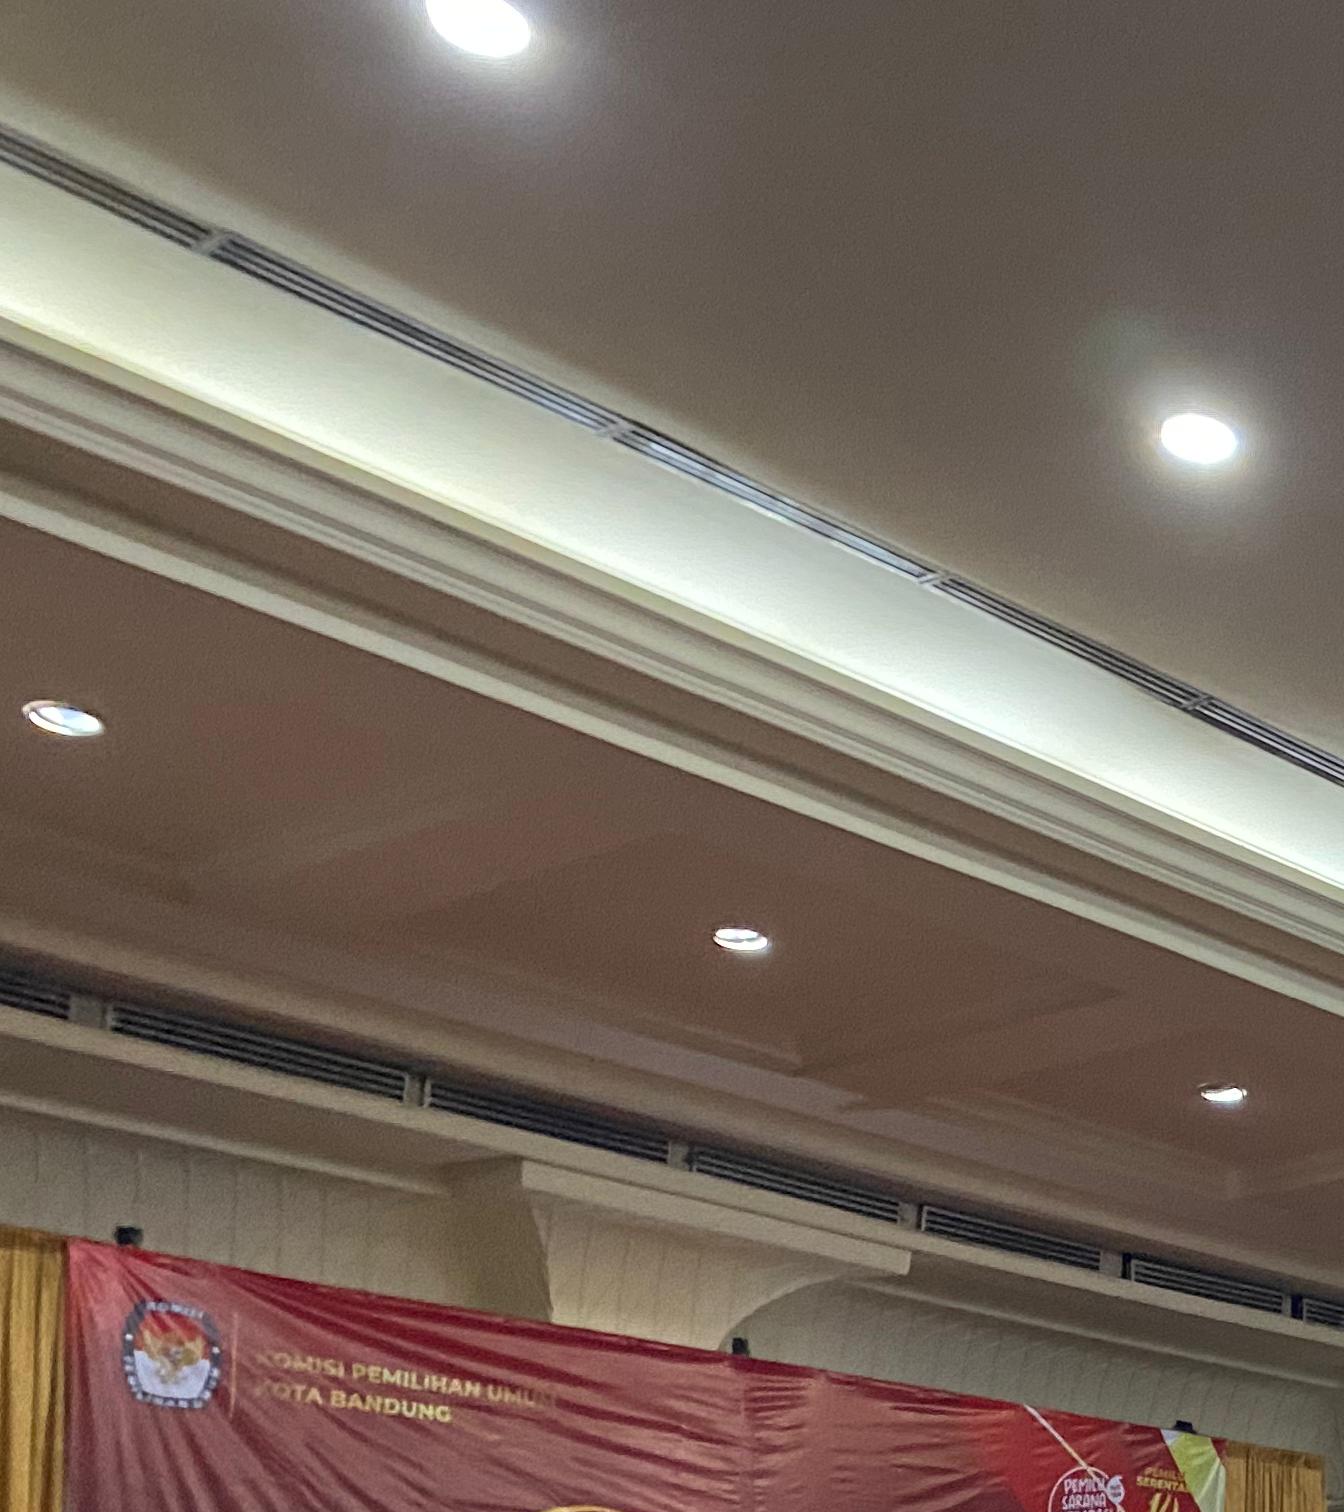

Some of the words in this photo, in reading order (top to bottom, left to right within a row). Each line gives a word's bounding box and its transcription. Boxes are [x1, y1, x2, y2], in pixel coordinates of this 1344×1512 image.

[352, 1363, 480, 1397] PEMILIHAN
[330, 1389, 453, 1423] BANDUNG
[1061, 1493, 1107, 1511] SARANA
